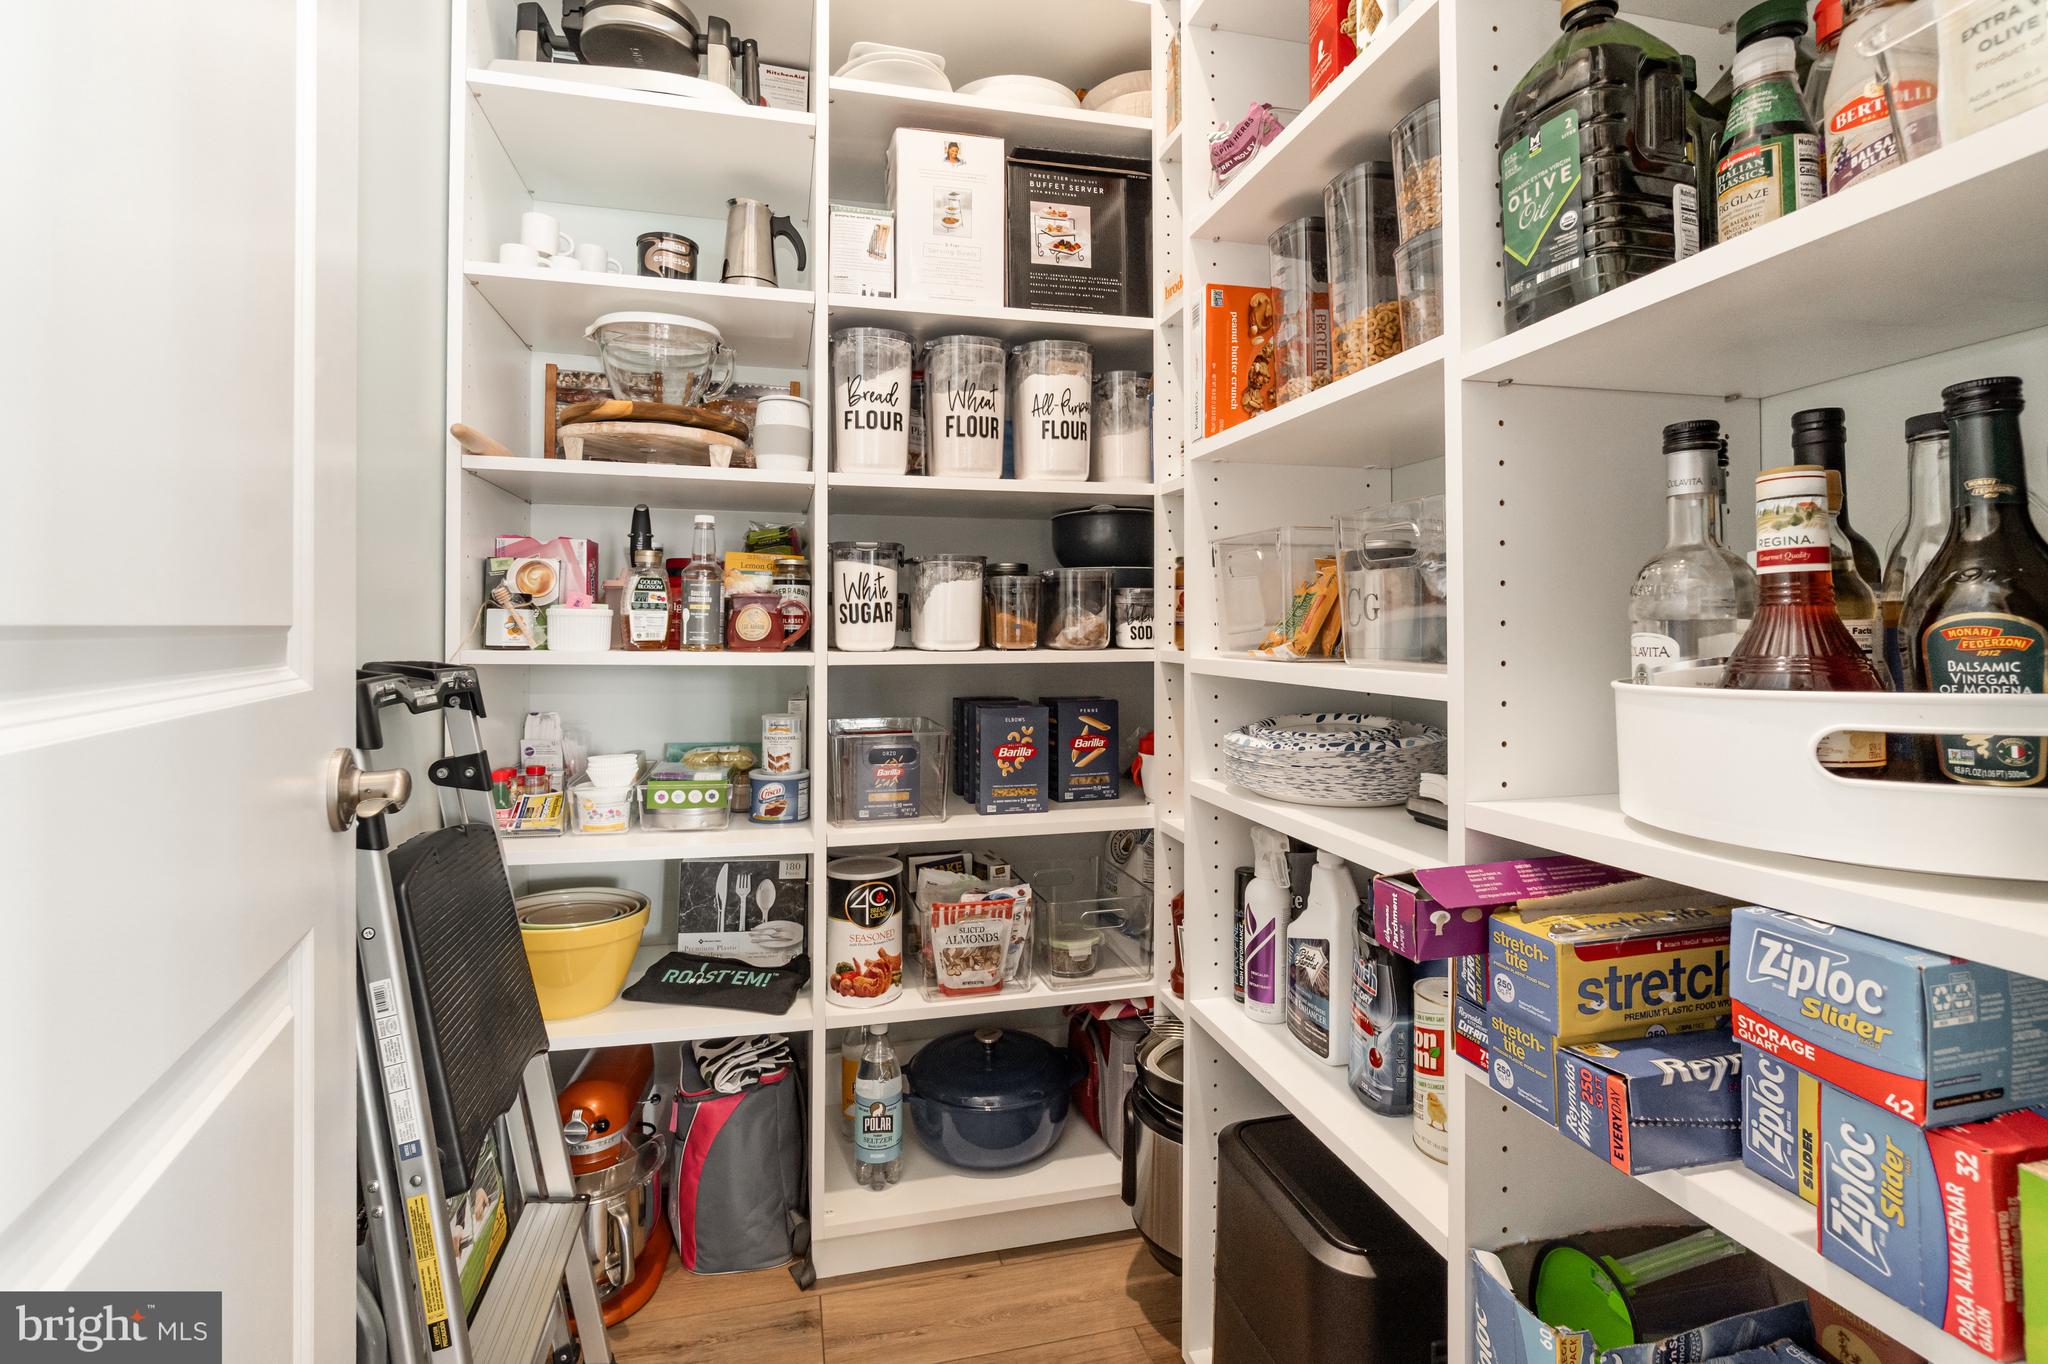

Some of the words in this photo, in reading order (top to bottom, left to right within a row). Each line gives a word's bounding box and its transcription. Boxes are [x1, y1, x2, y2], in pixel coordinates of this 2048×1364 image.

[1961, 5, 2021, 44] EXTRA
[1978, 15, 2040, 52] OLIVE
[766, 69, 805, 80] KitchenAid
[1233, 117, 1254, 141] HERBS
[1565, 117, 1573, 129] 2
[1550, 156, 1571, 171] VIRGIN
[1861, 144, 1898, 170] GLAZ
[1719, 157, 1765, 184] ITALIAN
[1719, 167, 1766, 194] CLASSICS
[1029, 180, 1065, 190] BUFFET
[1069, 184, 1105, 195] SERVER
[1508, 164, 1573, 213] OLIVE
[1730, 187, 1769, 207] GLAZE
[1519, 191, 1555, 230] Oil
[1230, 311, 1238, 343] peanut
[1231, 345, 1239, 374] butter
[847, 375, 899, 407] Bread
[948, 378, 999, 413] Wheat
[1230, 376, 1238, 410] crunch
[844, 410, 903, 432] FLOUR
[945, 415, 1000, 440] FLOUR
[1041, 420, 1088, 441] FLOUR
[740, 562, 765, 570] Lemon
[1760, 553, 1783, 562] Gourmet
[1784, 552, 1811, 562] Quality
[787, 587, 809, 599] RABBIT
[843, 571, 890, 603] White
[839, 601, 894, 625] SUGAR
[1130, 625, 1154, 640] SOD
[1948, 627, 1993, 638] MONARI
[1962, 639, 2027, 649] FEDERZONI
[1976, 649, 2001, 657] 1912
[1948, 660, 2021, 672] BALSAMIC
[1939, 685, 1957, 694] OF
[1964, 685, 2032, 694] MODENA
[1949, 672, 2019, 685] VINEGAR
[998, 748, 1033, 758] Barilla
[1074, 738, 1104, 748] Barilla
[877, 768, 901, 777] Barilla
[761, 786, 782, 800] Crisco
[849, 886, 889, 926] 4C
[849, 928, 895, 943] SEASONED
[945, 932, 999, 945] ALMONDS
[959, 926, 985, 934] SLICED
[1493, 930, 1549, 963] stretch-
[1504, 949, 1528, 972] tite
[1353, 958, 1378, 990] nish
[1465, 954, 1477, 1001] CUT-RI
[1497, 977, 1513, 991] 250
[1758, 936, 1884, 1015] Ziploc
[1458, 1006, 1483, 1026] Reynolds
[1624, 1009, 1661, 1021] PREMIUM
[1661, 1005, 1694, 1017] PLASTIC
[1695, 1001, 1716, 1011] FOOD
[1717, 1000, 1730, 1008] WR
[1800, 996, 1893, 1043] Slider
[1414, 1029, 1436, 1049] on
[1491, 1016, 1546, 1052] stretch-
[1737, 1013, 1816, 1062] STORAGE
[1738, 1028, 1779, 1055] QUART
[1414, 1050, 1436, 1070] mi
[1503, 1036, 1526, 1060] tite
[1496, 1062, 1511, 1078] 250
[1564, 1060, 1580, 1135] Reynolds
[1580, 1067, 1594, 1105] 250
[1751, 1060, 1795, 1164] Ziploc
[1885, 1093, 1916, 1120] 42
[864, 1117, 892, 1132] POLAR
[1578, 1101, 1593, 1148] Wrap
[1609, 1087, 1625, 1162] EVERYDAY
[863, 1136, 893, 1144] SELTZER
[1802, 1128, 1814, 1190] SLIDER
[1956, 1150, 1980, 1182] 32
[1830, 1120, 1889, 1257] Ziploc
[1880, 1134, 1905, 1228] Slider
[1946, 1182, 1973, 1292] ALMACENAR
[1957, 1291, 1980, 1344] PARA
[1539, 1327, 1553, 1351] 60
